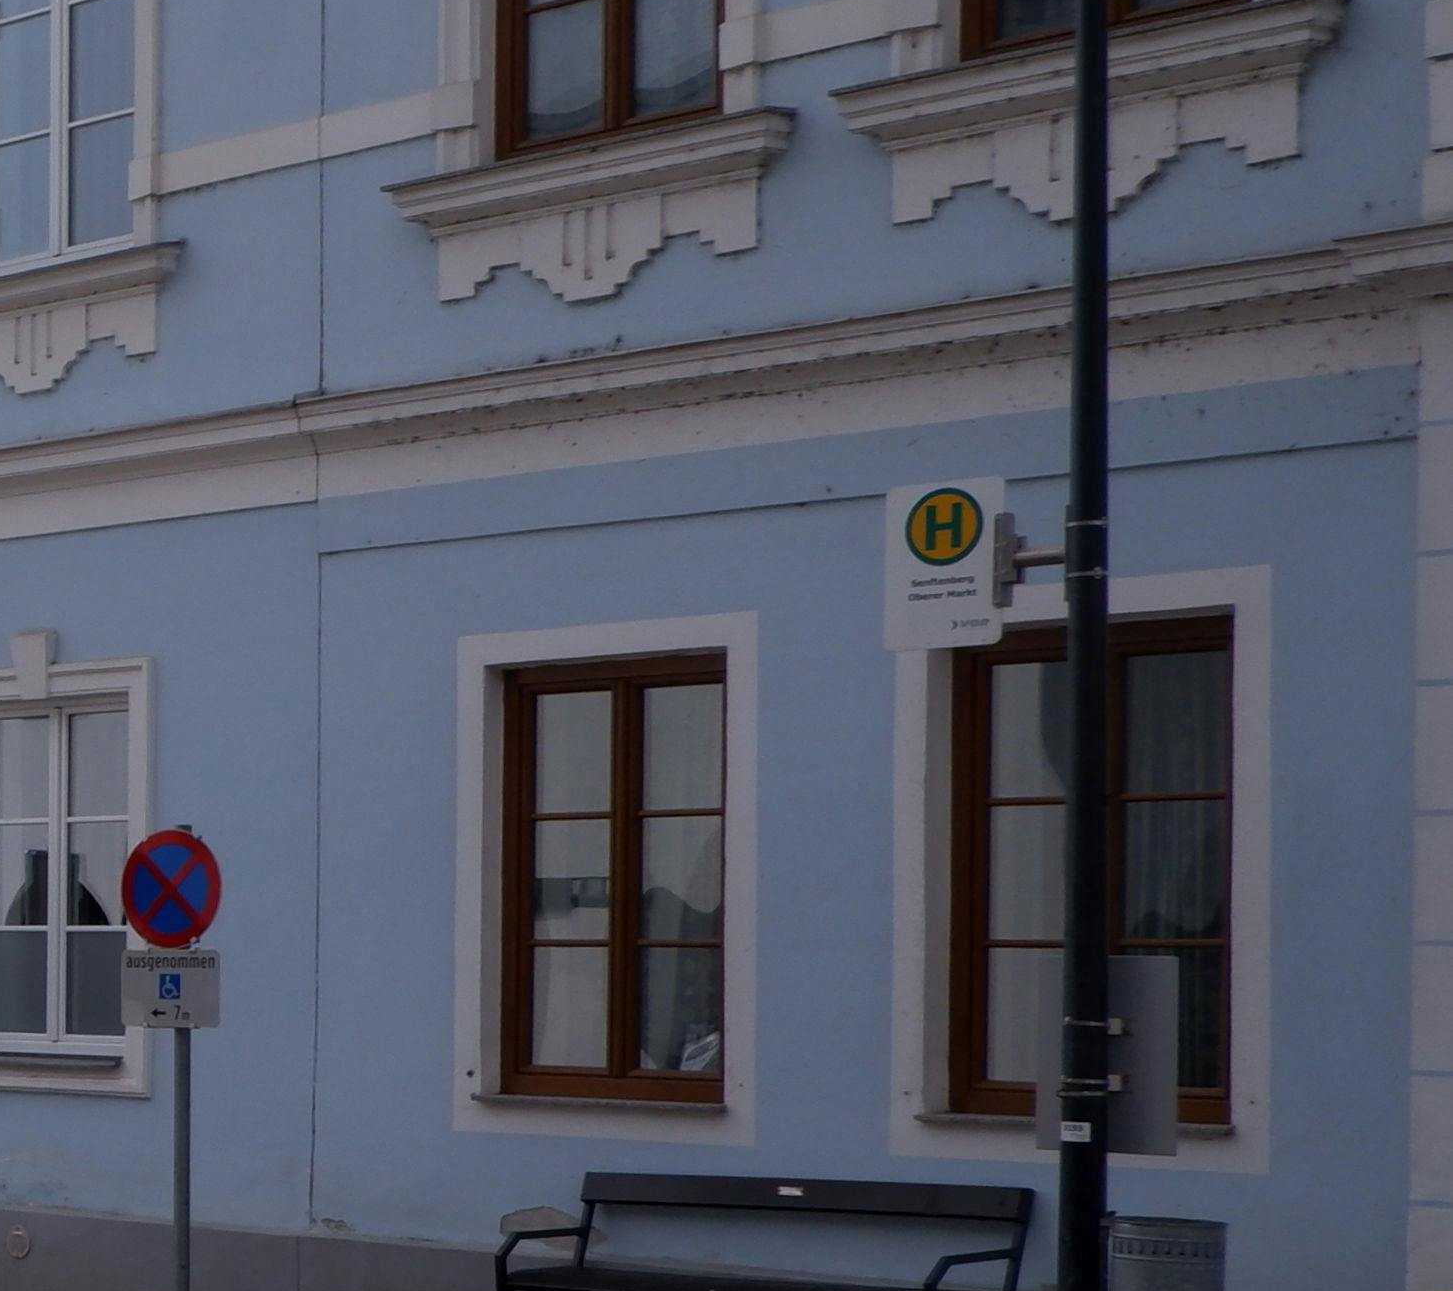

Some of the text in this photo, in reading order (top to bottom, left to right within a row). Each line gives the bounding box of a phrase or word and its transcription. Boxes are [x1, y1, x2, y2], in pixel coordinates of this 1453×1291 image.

[925, 502, 963, 551] H
[125, 956, 216, 972] ausgenommen
[174, 1005, 182, 1020] 7
